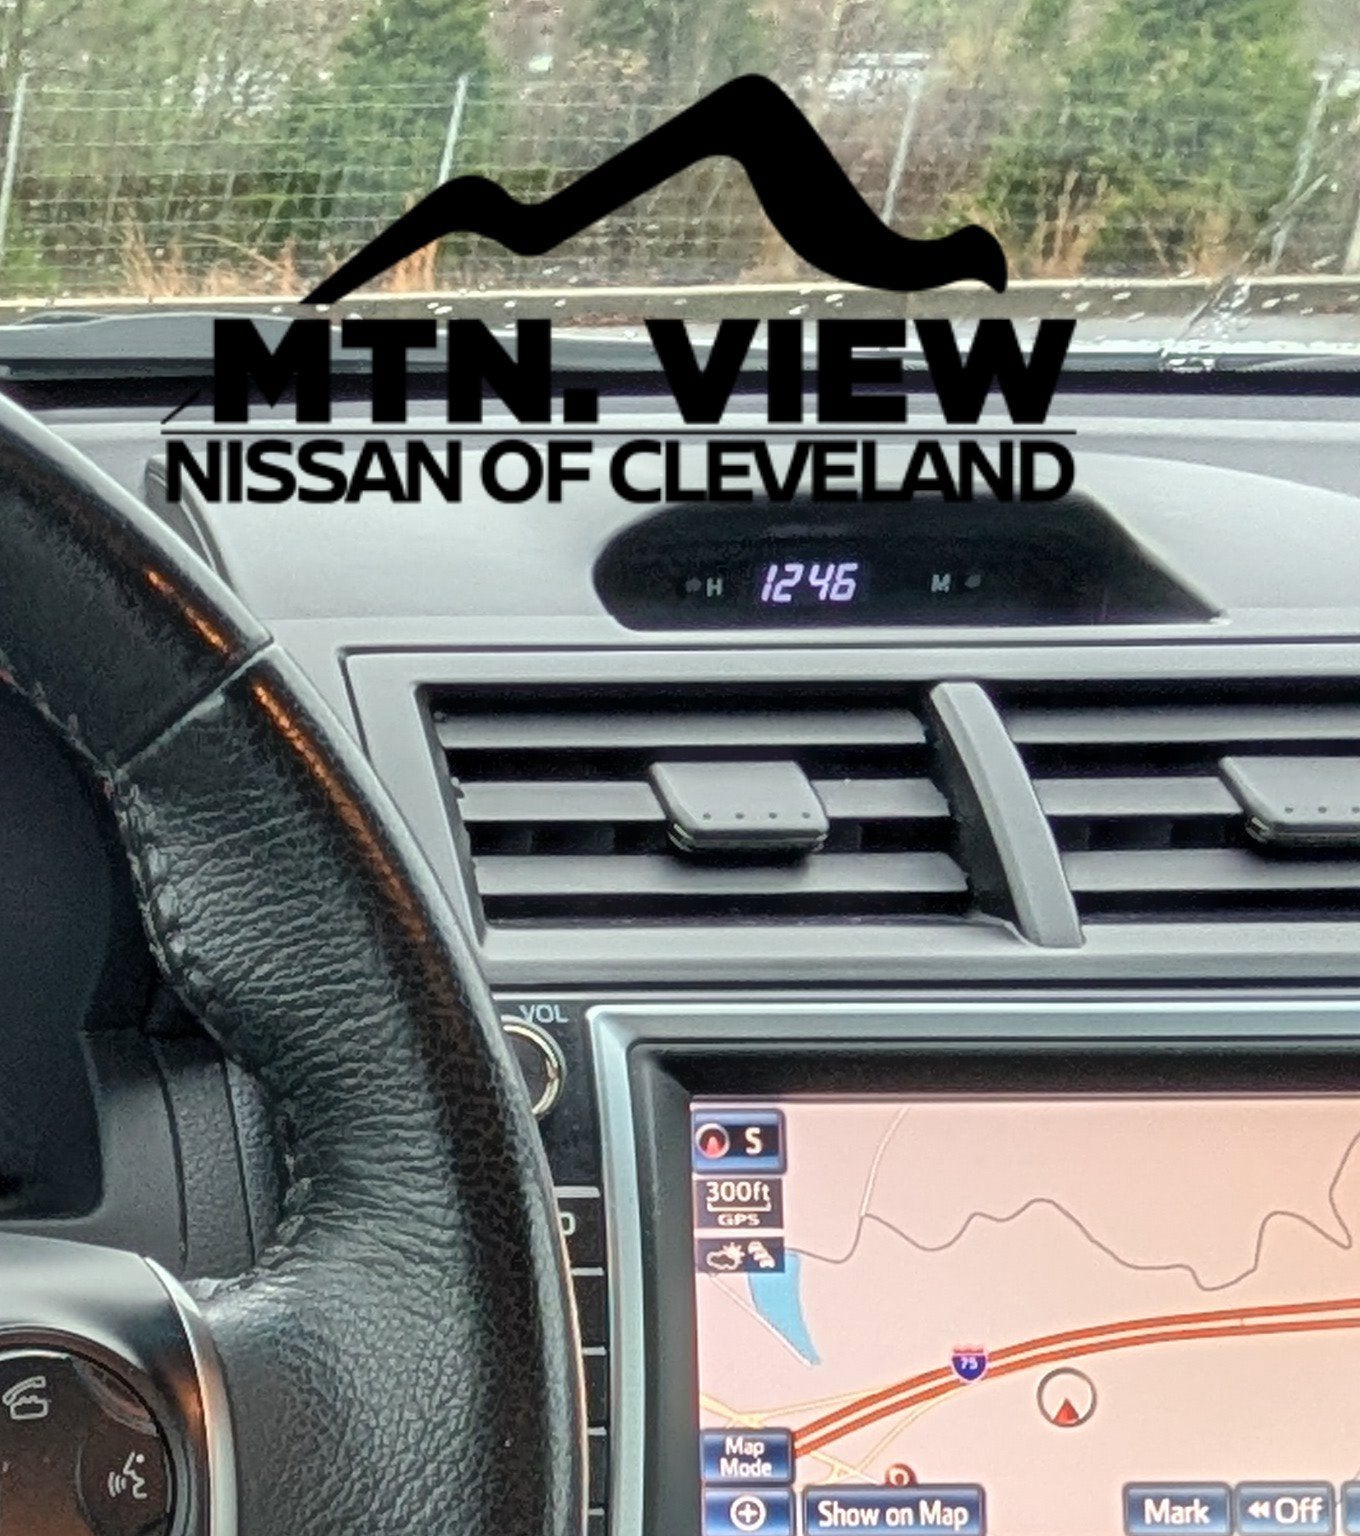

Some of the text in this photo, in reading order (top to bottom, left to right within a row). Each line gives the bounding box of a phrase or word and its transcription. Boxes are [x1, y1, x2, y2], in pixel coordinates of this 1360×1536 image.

[518, 1003, 569, 1024] VOL
[744, 1127, 762, 1155] S
[706, 1180, 771, 1202] 300ft
[717, 1212, 761, 1227] GPS
[959, 1357, 979, 1370] 75
[725, 1437, 765, 1458] Map
[720, 1458, 773, 1478] Mode
[818, 1501, 970, 1533] Show on Map
[1144, 1499, 1209, 1526] Mark
[1274, 1496, 1324, 1524] Off
